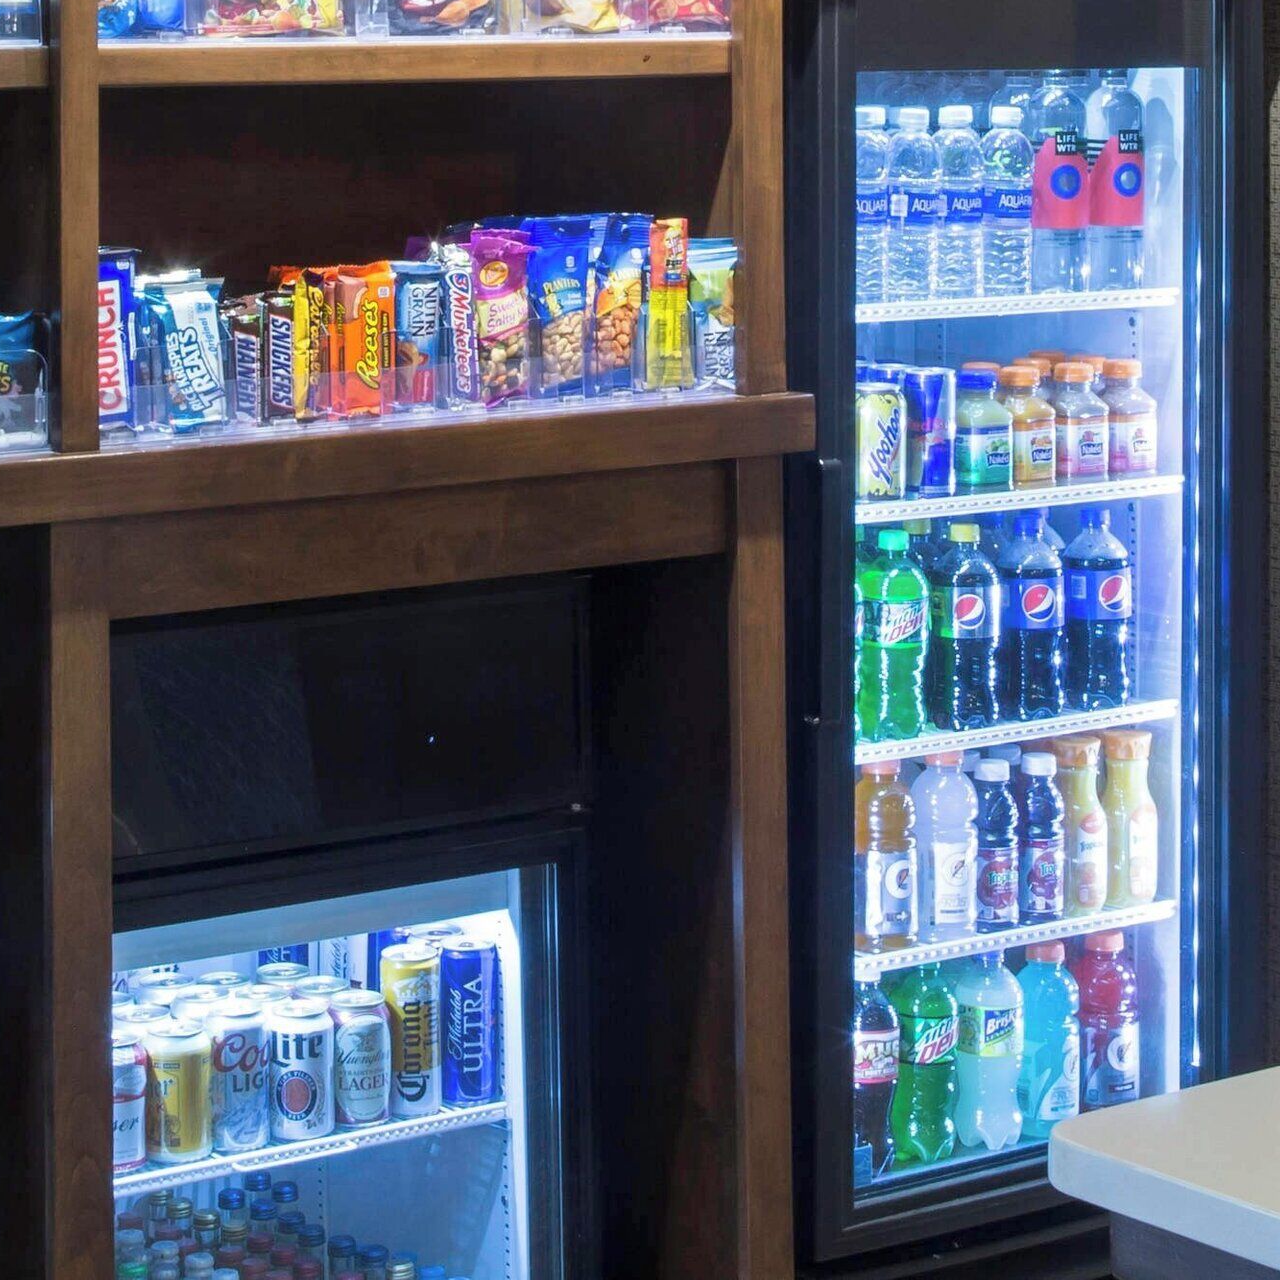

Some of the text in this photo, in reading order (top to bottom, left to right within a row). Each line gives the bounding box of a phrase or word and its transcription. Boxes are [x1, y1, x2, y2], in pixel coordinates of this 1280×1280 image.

[1056, 133, 1077, 144] LIFE
[1056, 144, 1076, 154] WTR
[1119, 133, 1139, 143] LIFE
[1119, 143, 1139, 152] WTR
[411, 286, 426, 337] GRAIN
[98, 286, 122, 410] CRUNCH
[179, 326, 226, 409] TREATS
[270, 316, 294, 410] SNICKERS
[463, 972, 485, 1074] ULTRA
[271, 1030, 324, 1068] Lite
[396, 1000, 430, 1103] Corona
[338, 1073, 389, 1093] LAGER
